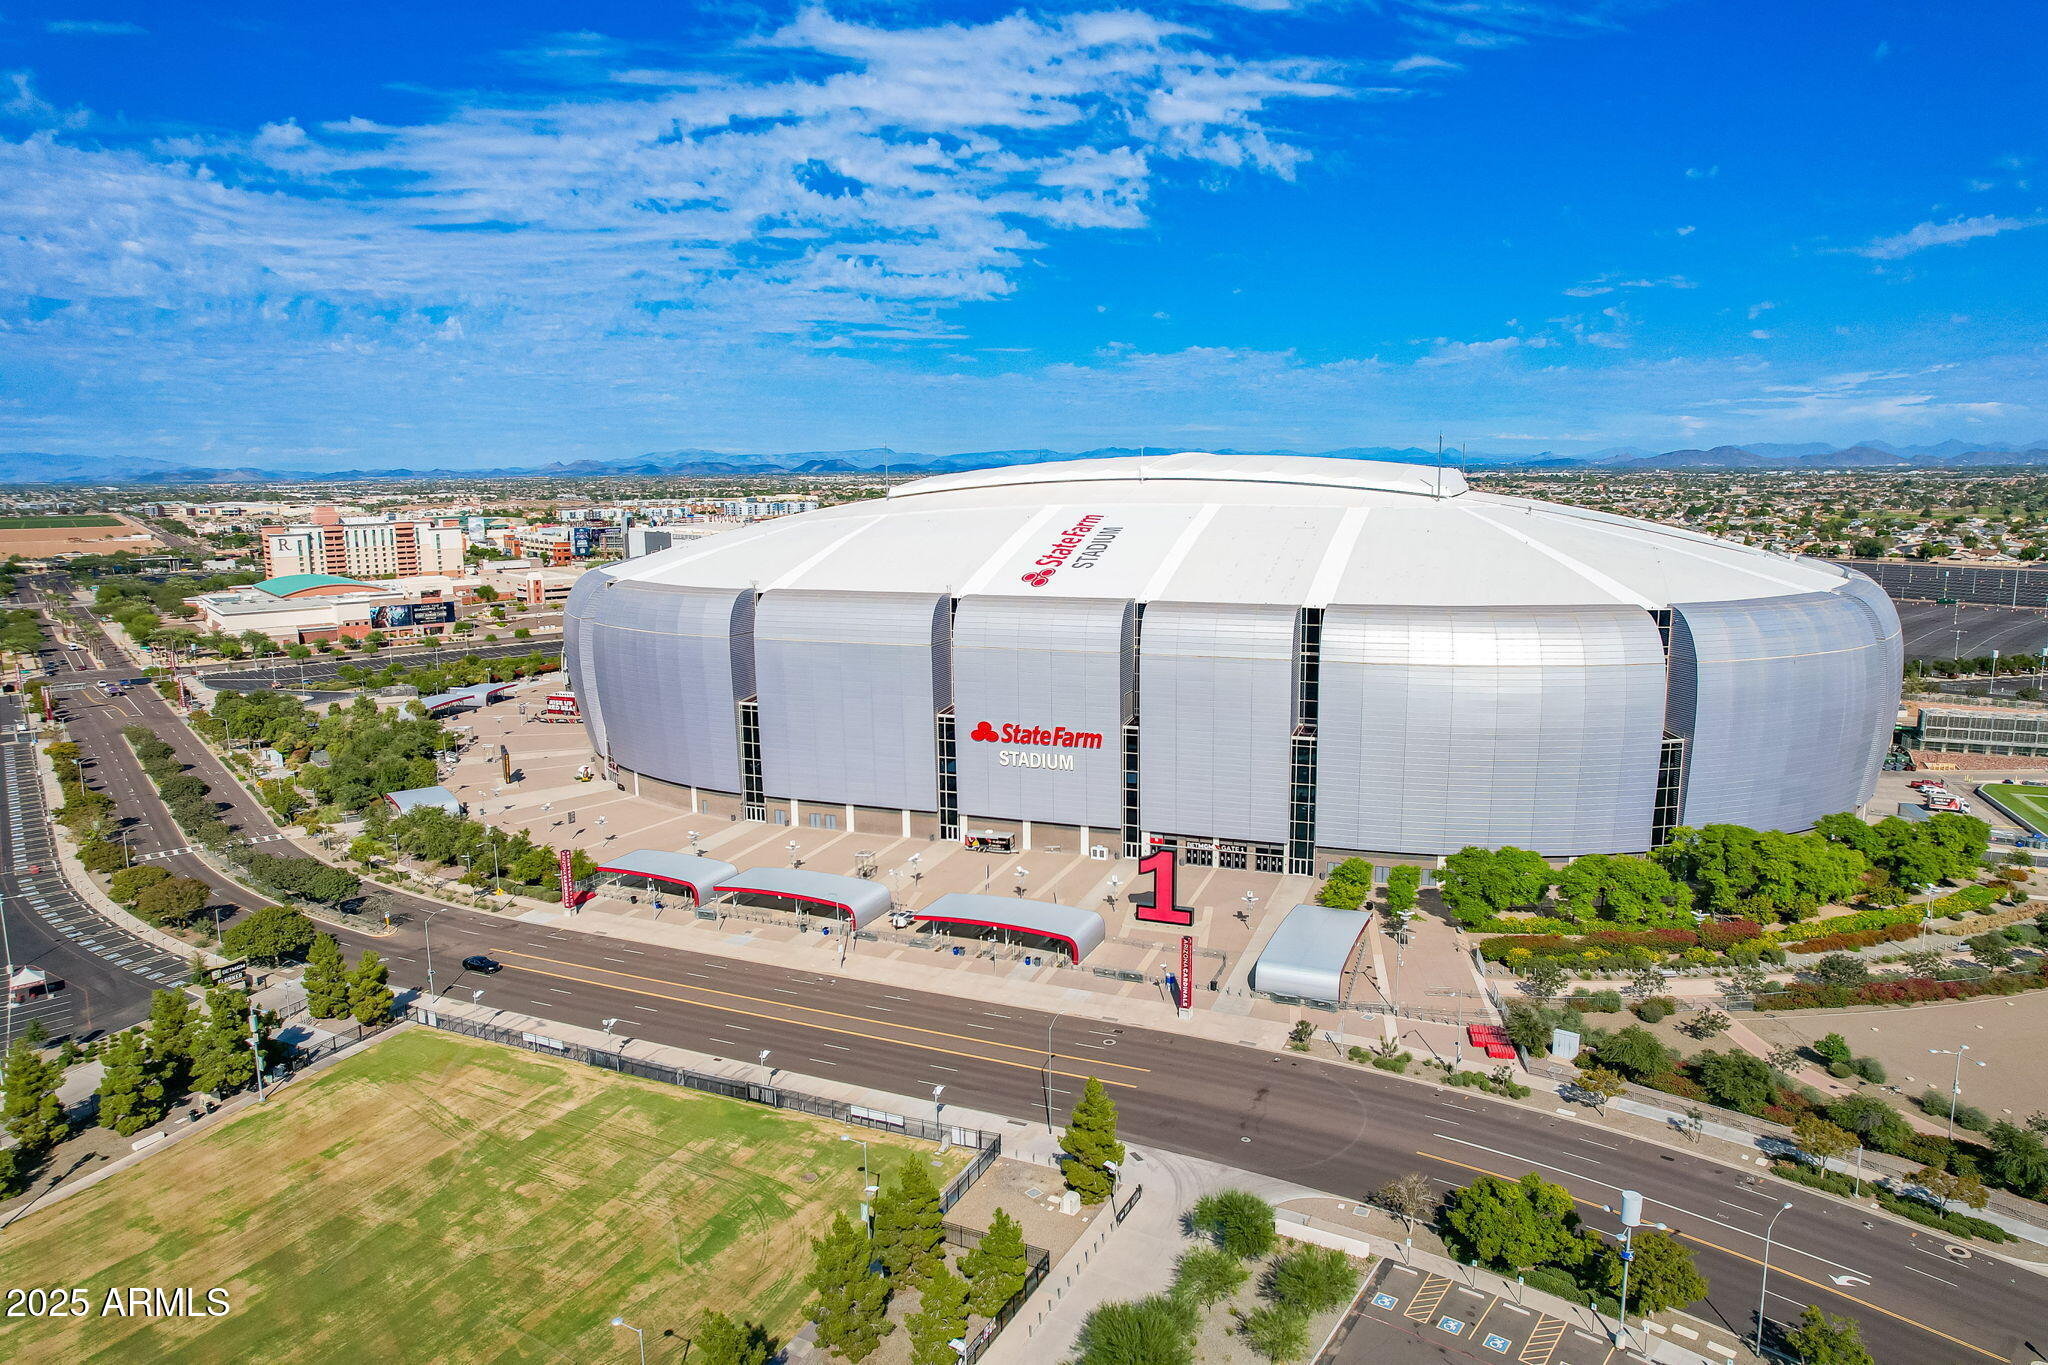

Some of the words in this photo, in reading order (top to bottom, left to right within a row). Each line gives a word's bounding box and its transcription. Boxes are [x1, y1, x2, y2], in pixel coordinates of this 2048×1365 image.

[278, 539, 292, 551] R
[1071, 526, 1124, 568] STADIUM
[1000, 750, 1074, 771] STADIUM
[1136, 847, 1194, 927] 1
